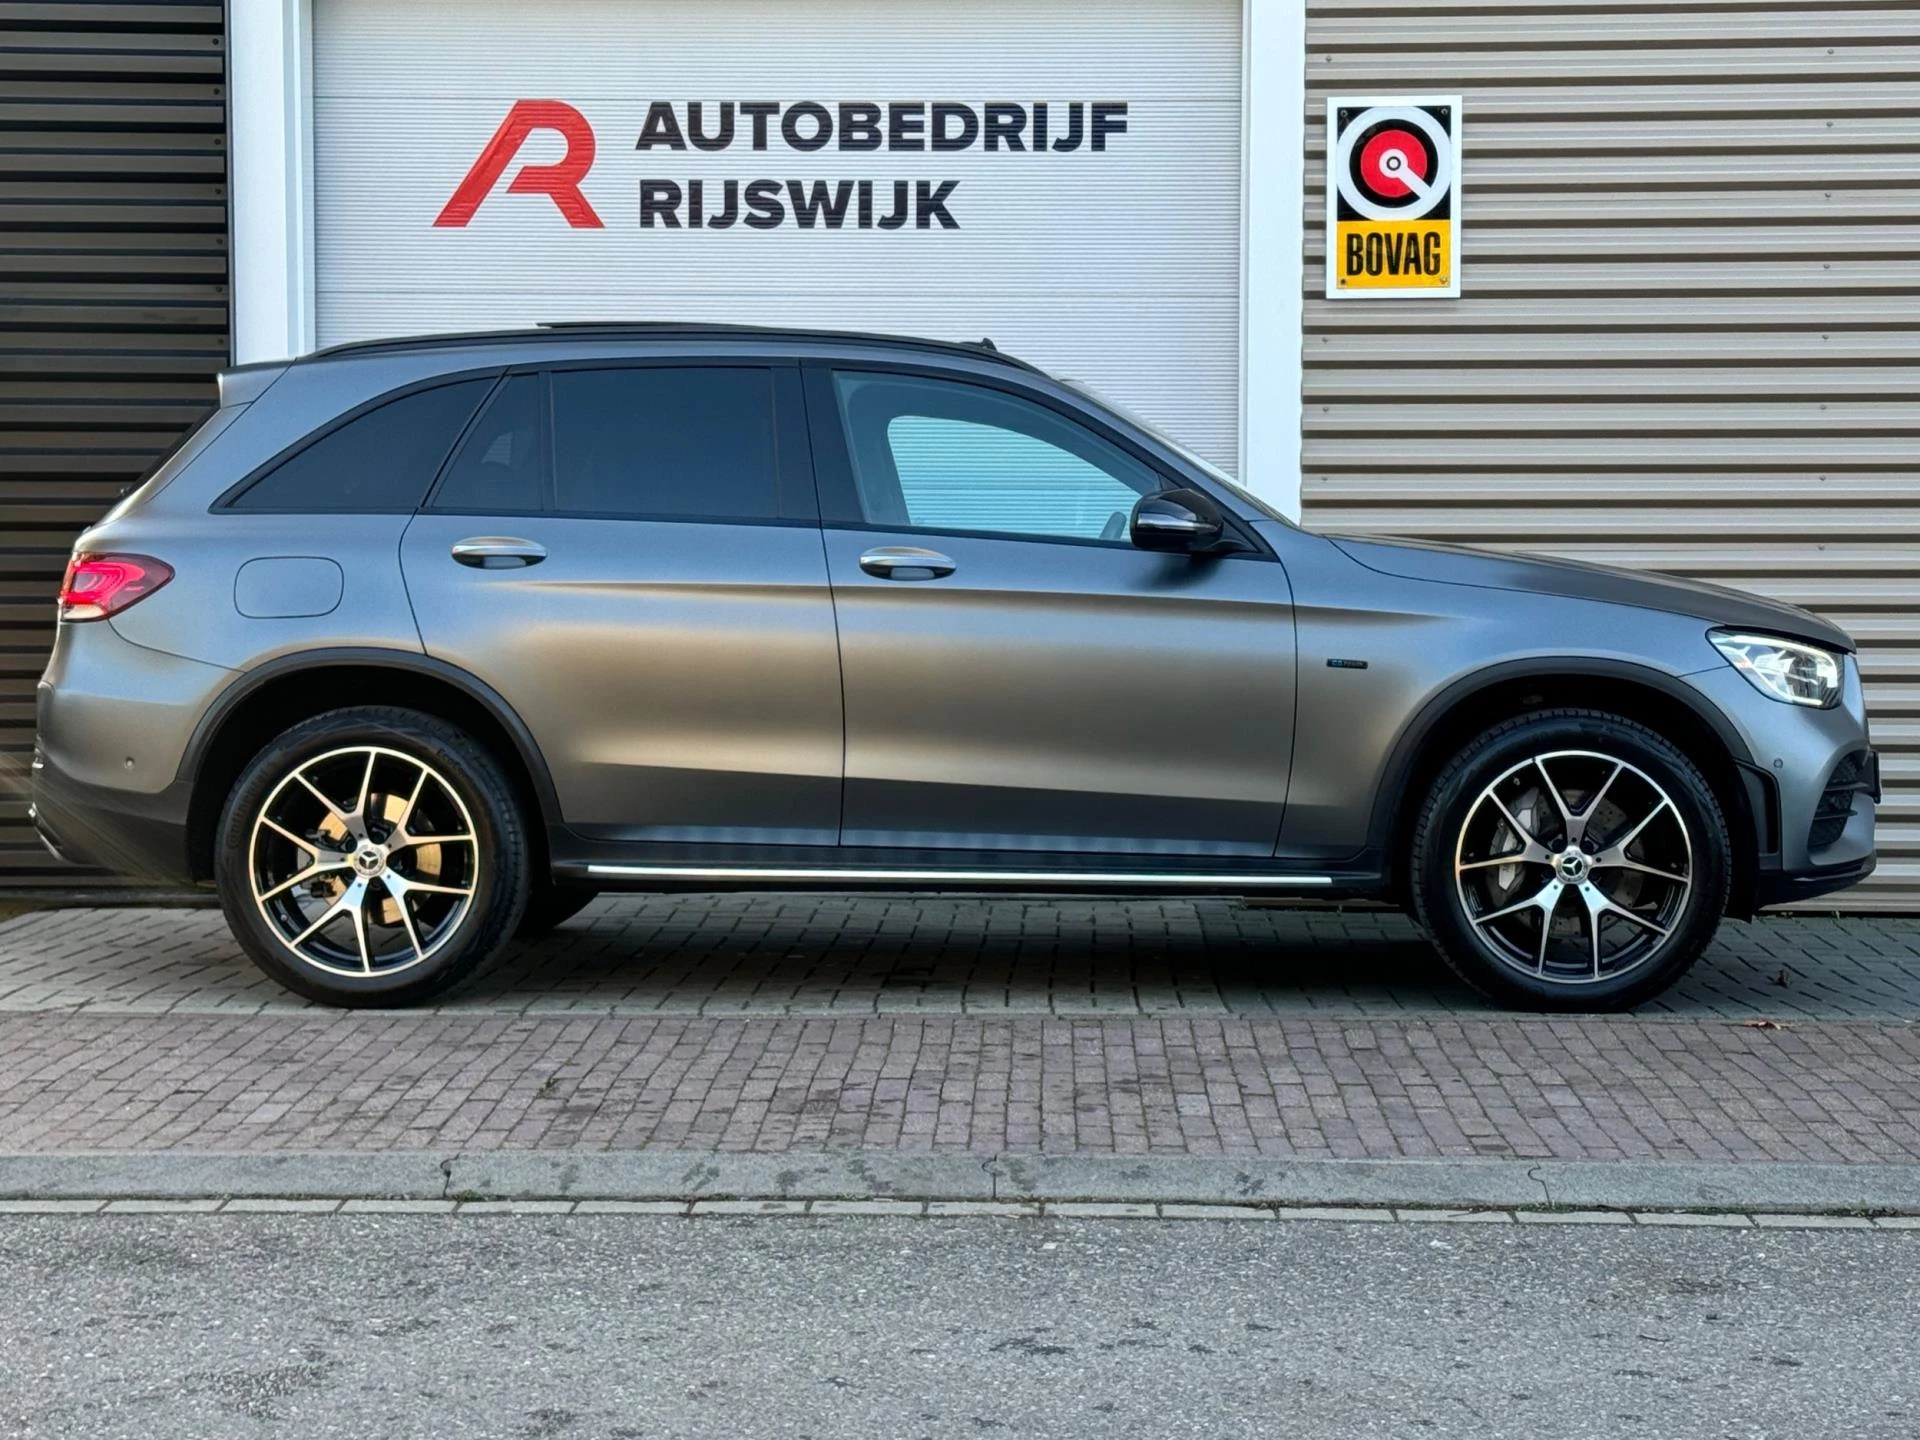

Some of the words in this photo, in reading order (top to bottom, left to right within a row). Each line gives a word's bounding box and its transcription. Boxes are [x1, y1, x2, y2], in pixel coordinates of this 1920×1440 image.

[635, 101, 1128, 152] AUTOBEDRIJF
[639, 179, 960, 230] RIJSWIJK
[1346, 231, 1441, 277] BOVAG
